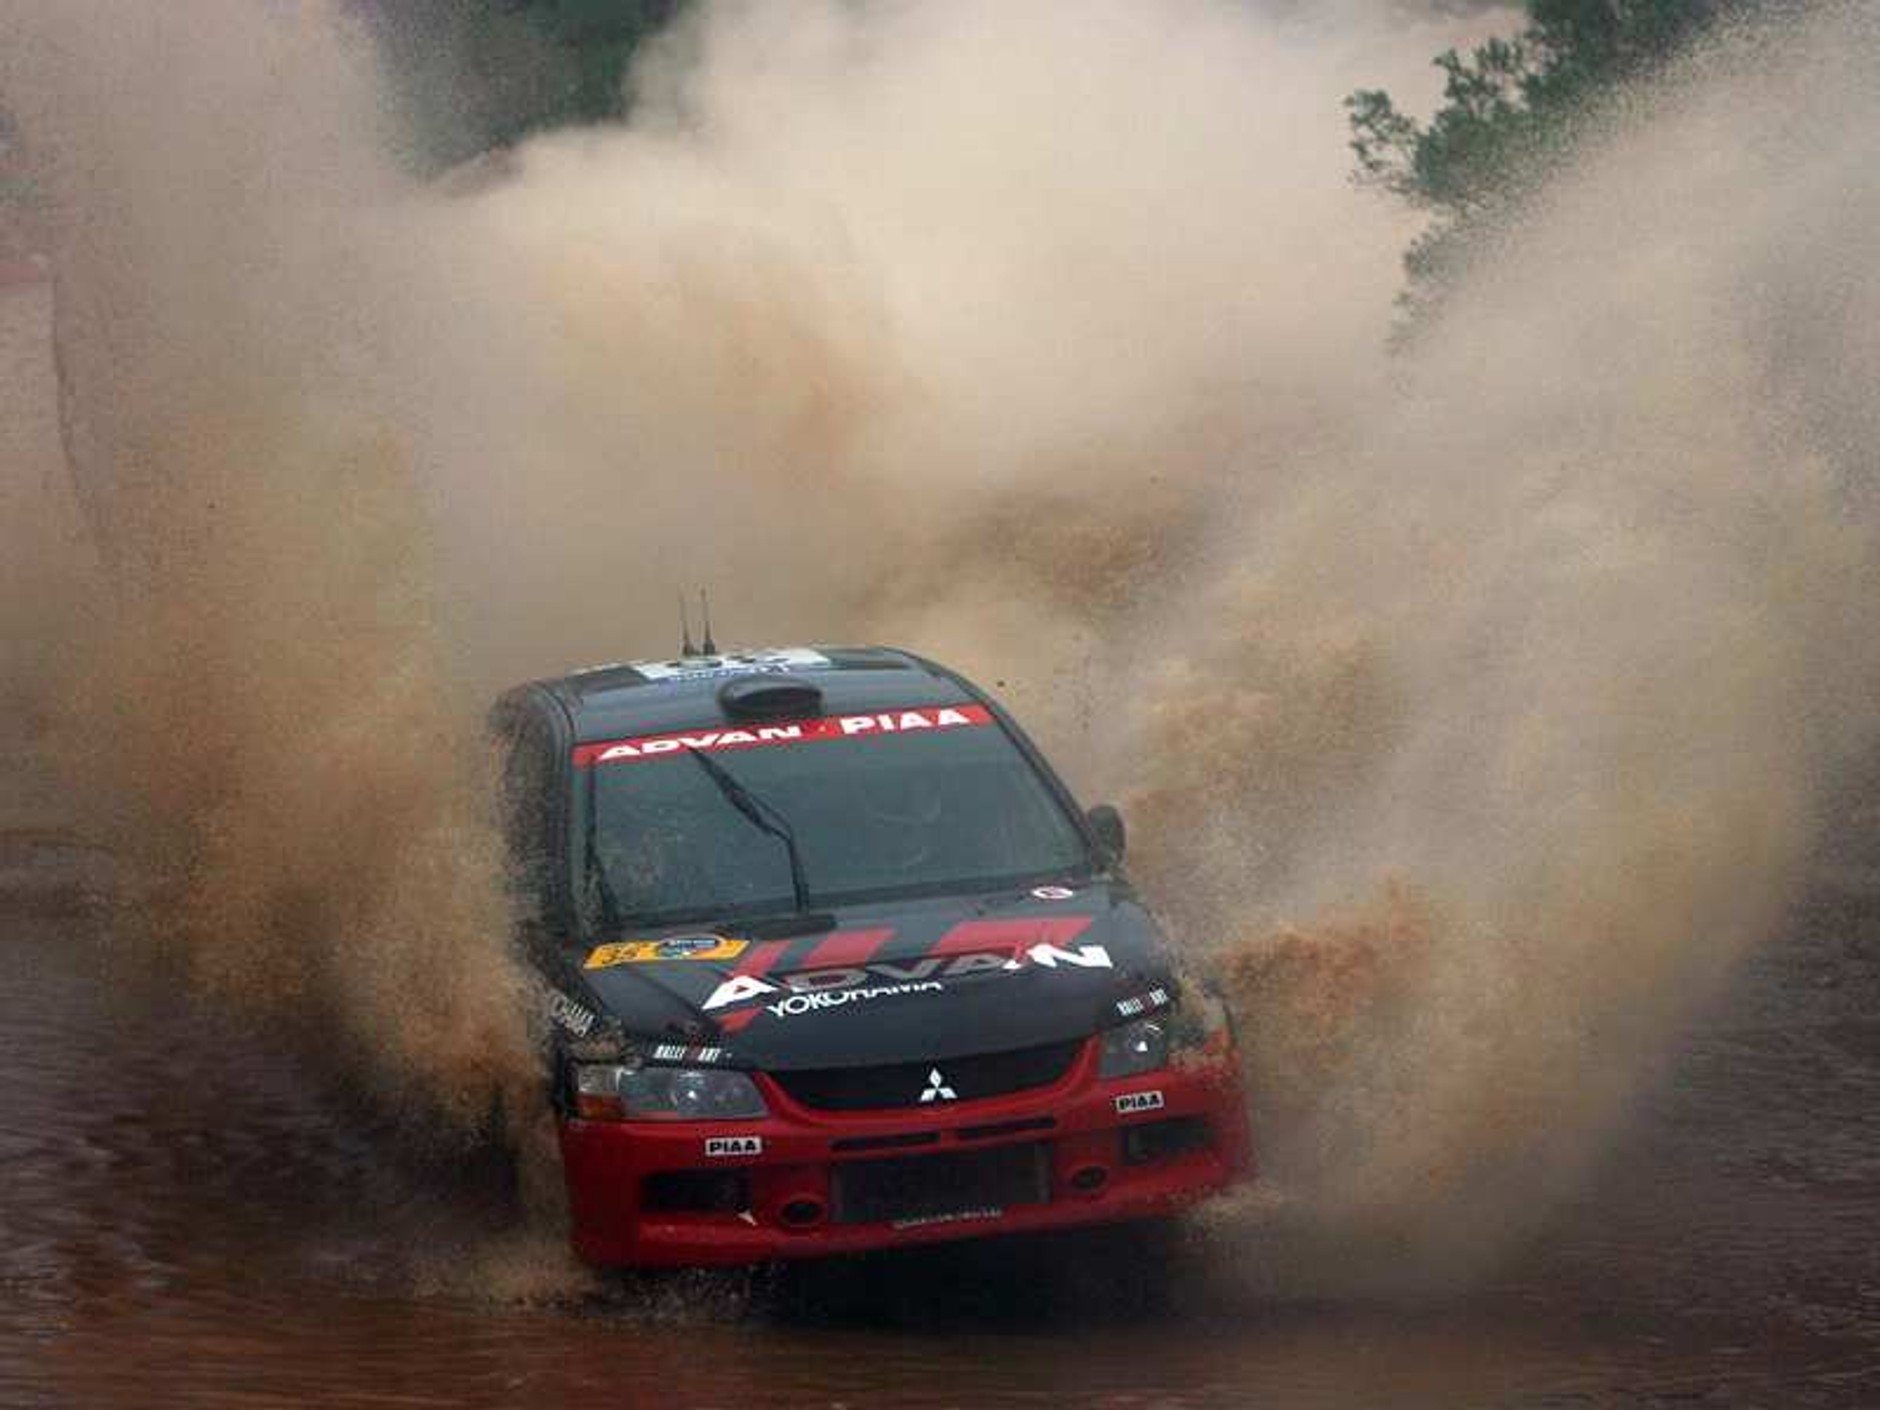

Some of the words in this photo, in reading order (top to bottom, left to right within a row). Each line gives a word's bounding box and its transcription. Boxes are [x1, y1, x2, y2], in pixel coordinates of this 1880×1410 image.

[597, 725, 803, 760] ADVAN
[838, 708, 971, 735] PIAA
[702, 943, 1113, 1010] ADVAN
[1118, 1092, 1161, 1110] PIAA
[708, 1138, 758, 1154] PIAA
